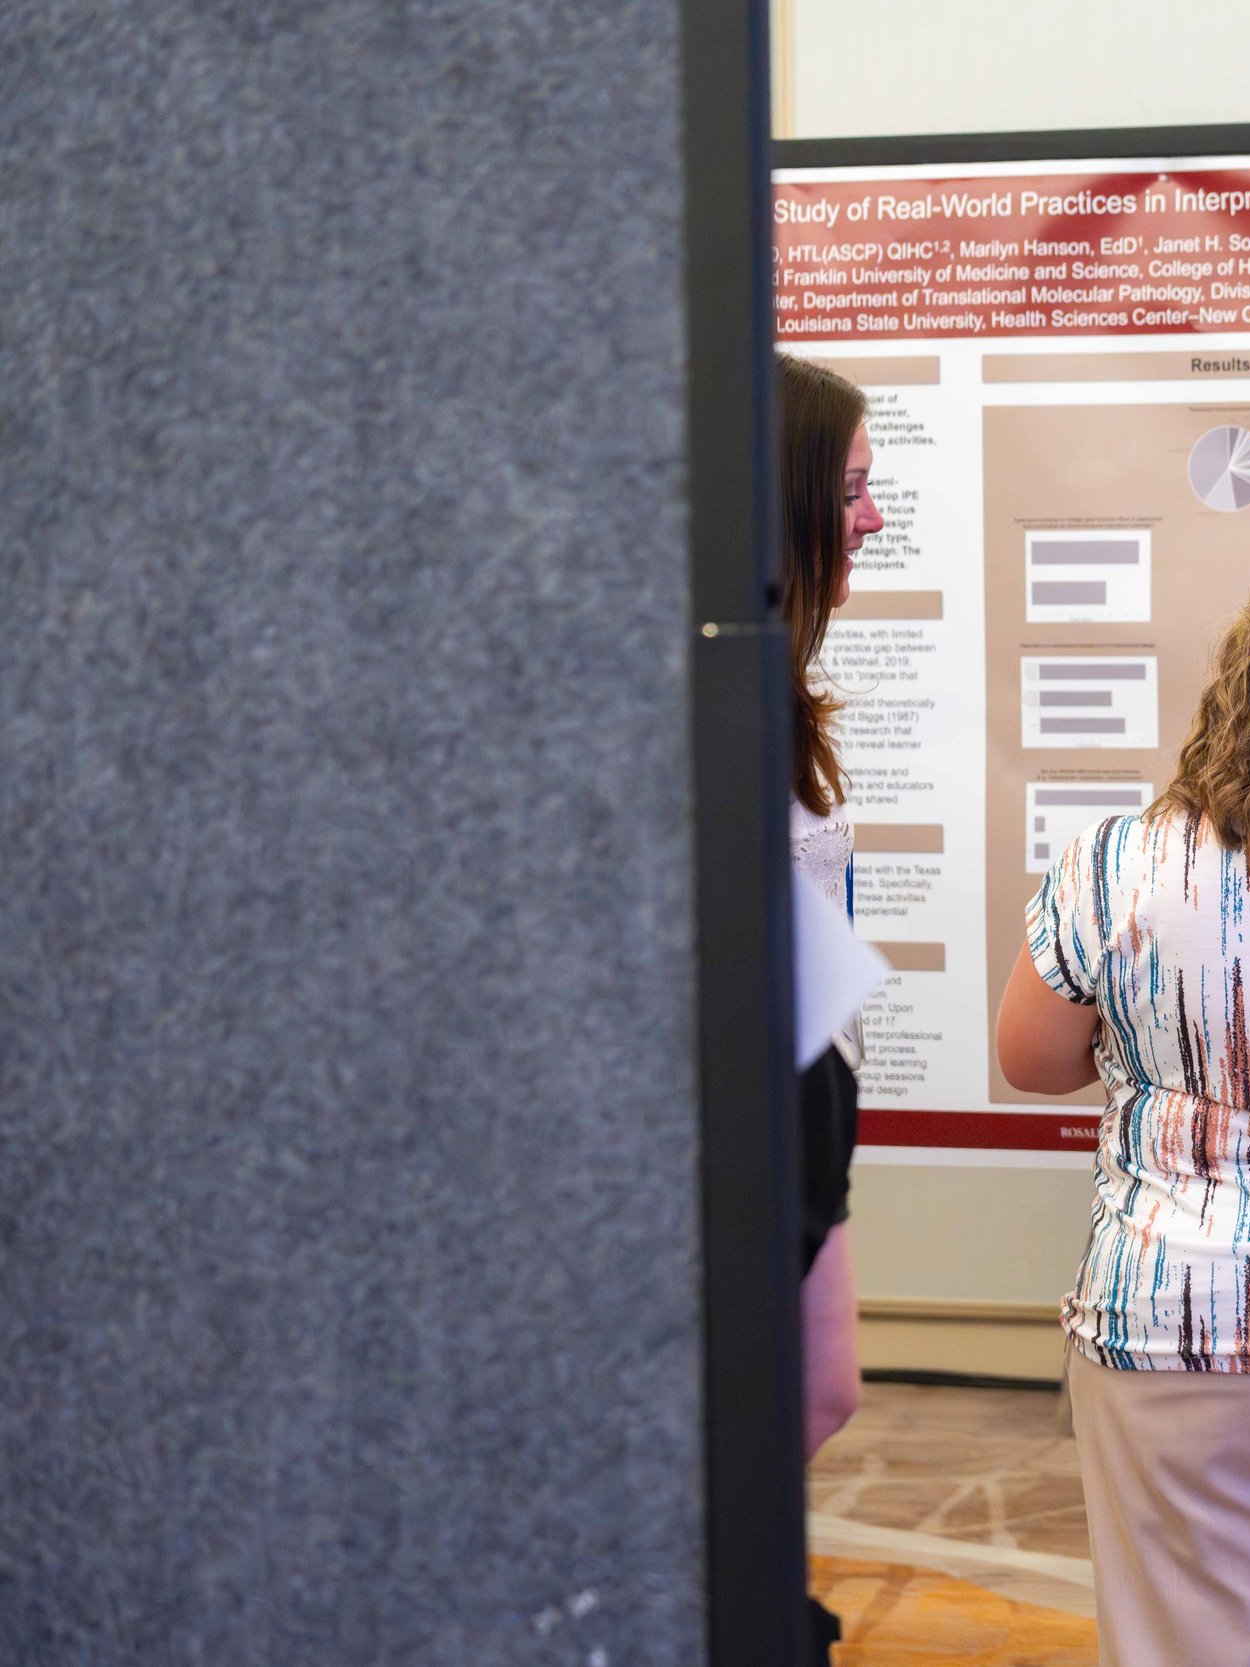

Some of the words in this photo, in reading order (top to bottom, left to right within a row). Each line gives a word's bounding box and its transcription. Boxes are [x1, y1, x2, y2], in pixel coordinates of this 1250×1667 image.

[774, 199, 839, 226] Study
[846, 196, 870, 220] of
[877, 193, 1011, 218] Real-World
[1020, 192, 1136, 214] Practices
[1144, 189, 1166, 212] in
[788, 243, 882, 263] HTL(ASCP)
[960, 240, 1018, 259] Marilyn
[1024, 240, 1094, 255] Hanson,
[1153, 237, 1199, 252] Janet
[784, 269, 846, 285] Franklin
[852, 267, 931, 285] University
[935, 264, 952, 282] of
[956, 264, 1029, 280] Medicine
[1034, 263, 1066, 279] and
[1072, 262, 1142, 278] Science,
[1148, 260, 1212, 279] College
[1217, 258, 1234, 275] of
[773, 295, 797, 309] ter,
[803, 292, 897, 309] Department
[901, 289, 918, 306] of
[922, 288, 1025, 304] Translational
[1031, 286, 1114, 302] Molecular
[1118, 284, 1204, 303] Pathology,
[777, 316, 851, 332] Louisiana
[856, 314, 898, 330] State
[903, 313, 985, 331] University,
[991, 311, 1046, 327] Health
[1051, 310, 1128, 326] Sciences
[1191, 357, 1250, 372] Results
[1060, 1126, 1099, 1138] ROSAL
